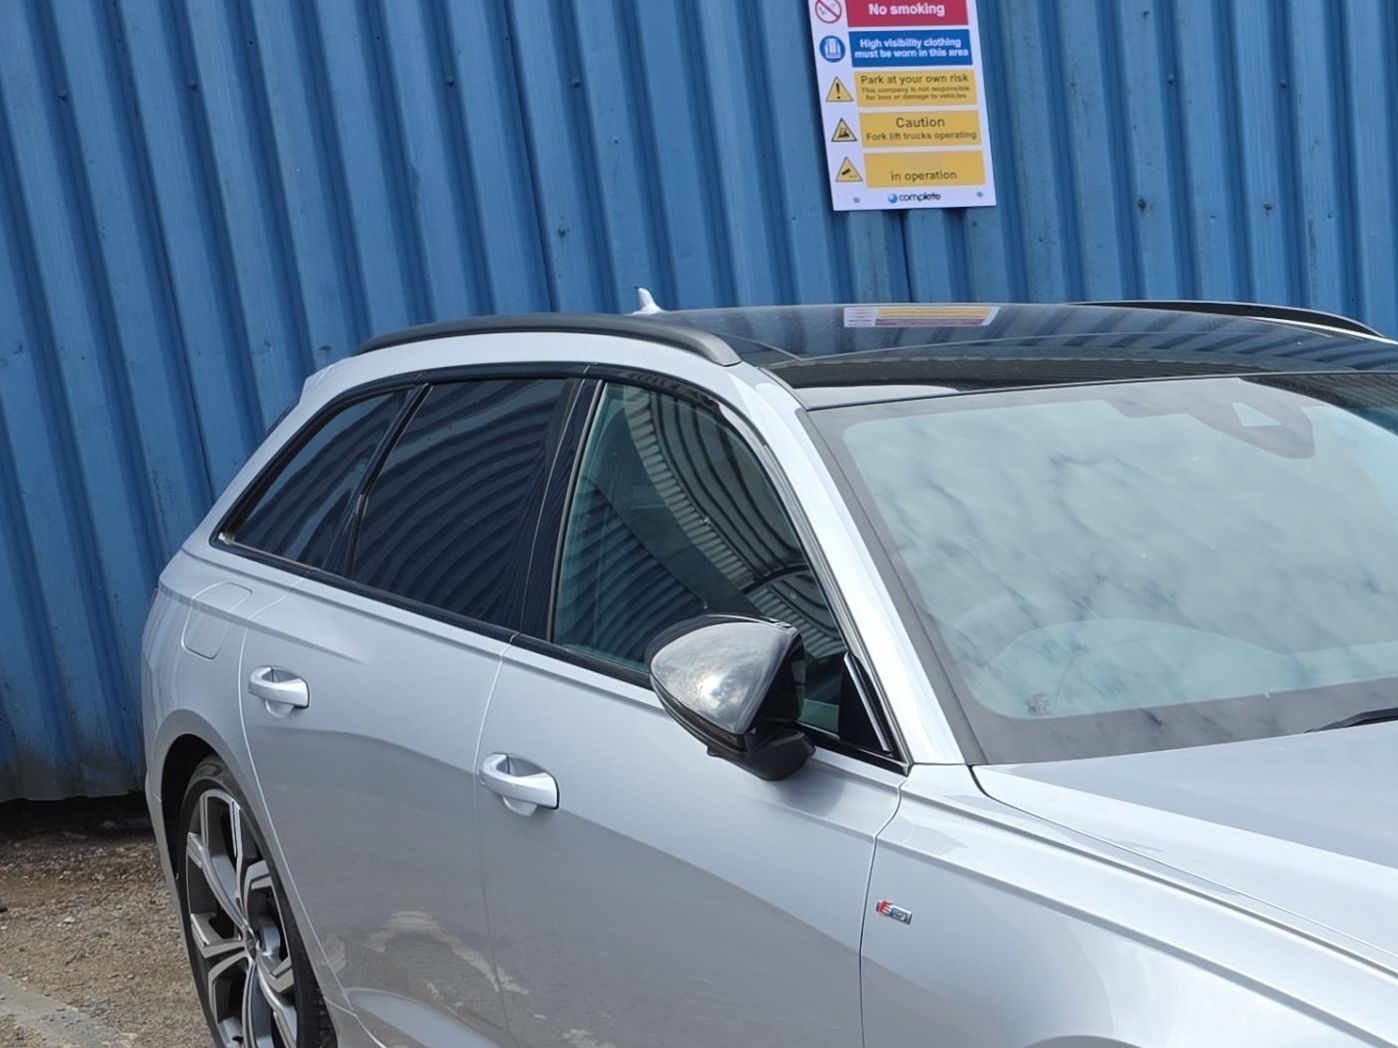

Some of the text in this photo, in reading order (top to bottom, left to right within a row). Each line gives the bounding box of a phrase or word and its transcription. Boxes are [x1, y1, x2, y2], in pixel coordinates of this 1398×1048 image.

[868, 3, 945, 17] No smoking
[860, 38, 962, 49] High visibility clothing
[855, 50, 879, 58] must
[880, 49, 892, 58] be
[919, 48, 927, 56] in
[929, 48, 946, 57] this
[860, 73, 969, 86] Park at your own risk
[895, 116, 946, 128] Caution
[866, 131, 978, 141] Fork lift trucks operating
[890, 170, 957, 182] in operation
[899, 192, 942, 202] complete
